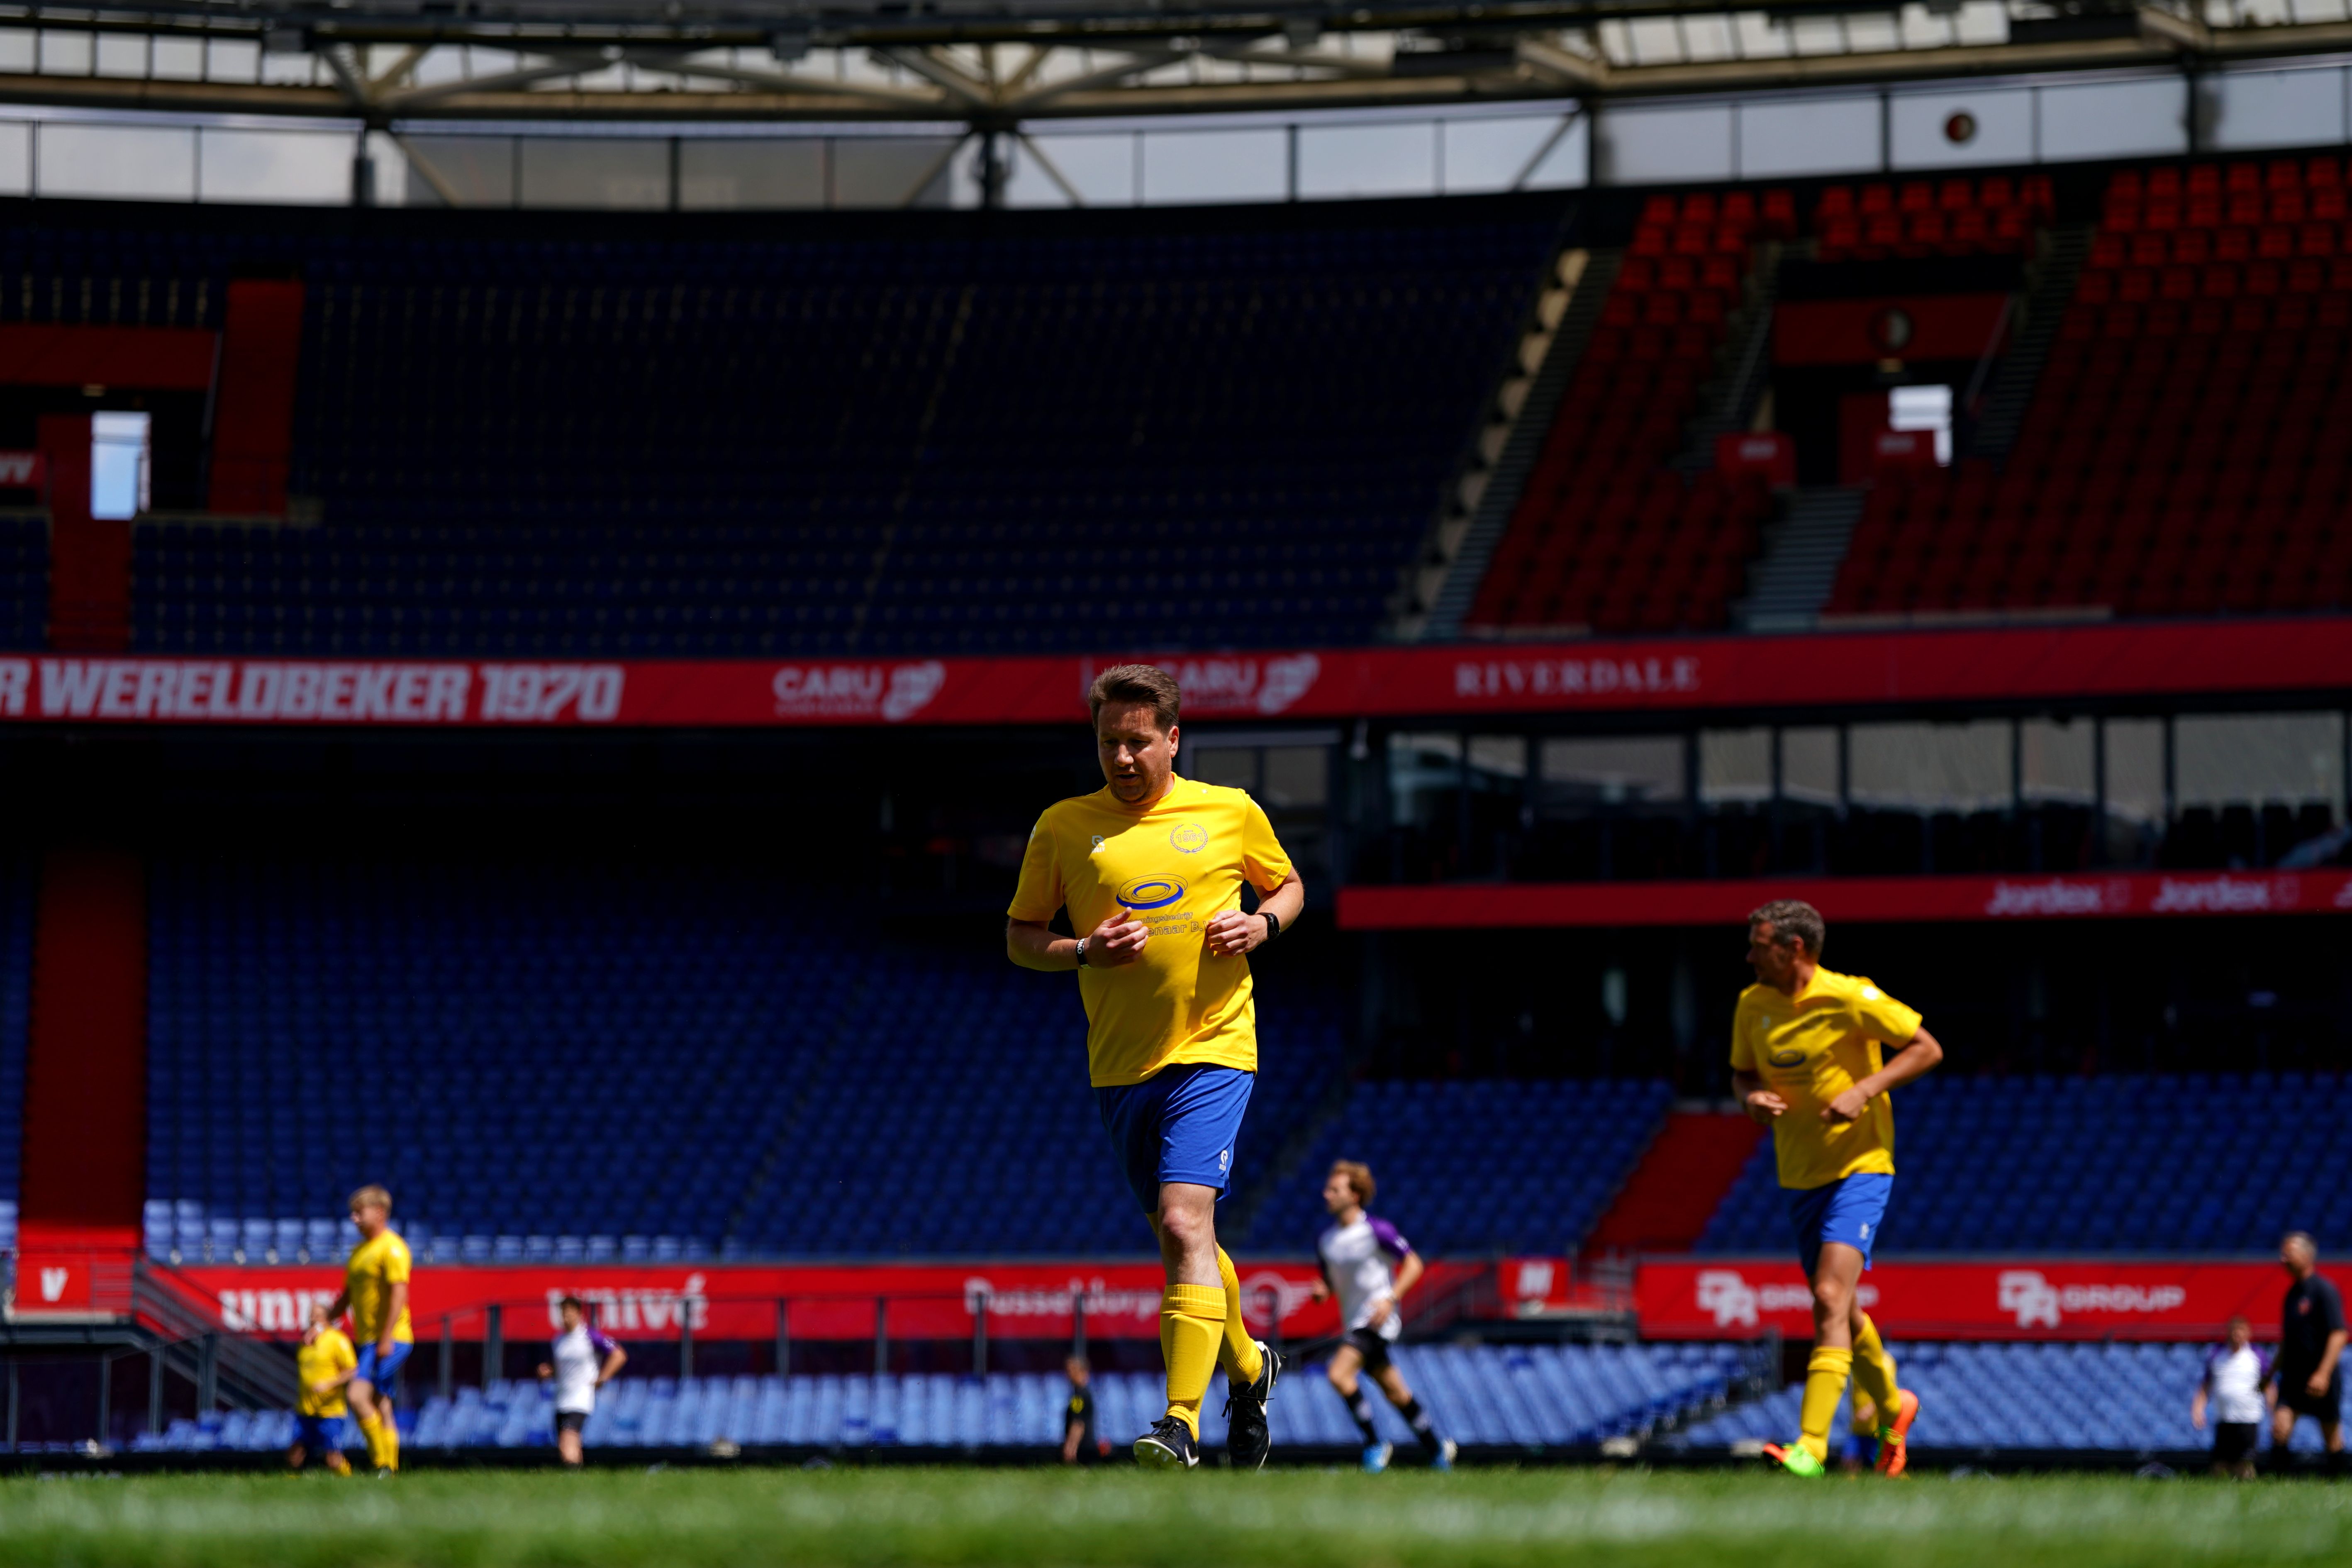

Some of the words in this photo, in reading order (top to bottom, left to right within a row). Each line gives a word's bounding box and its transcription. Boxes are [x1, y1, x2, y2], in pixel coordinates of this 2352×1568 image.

[39, 659, 471, 720] WERELDBEKER
[480, 664, 624, 720] 1970
[773, 667, 882, 700] CARU
[1455, 658, 1698, 695] RIVERDALE
[1176, 833, 1203, 843] 1961
[1124, 912, 1193, 924] mingsbedrijf
[1148, 924, 1187, 937] enaar
[2063, 1285, 2185, 1311] GROUP
